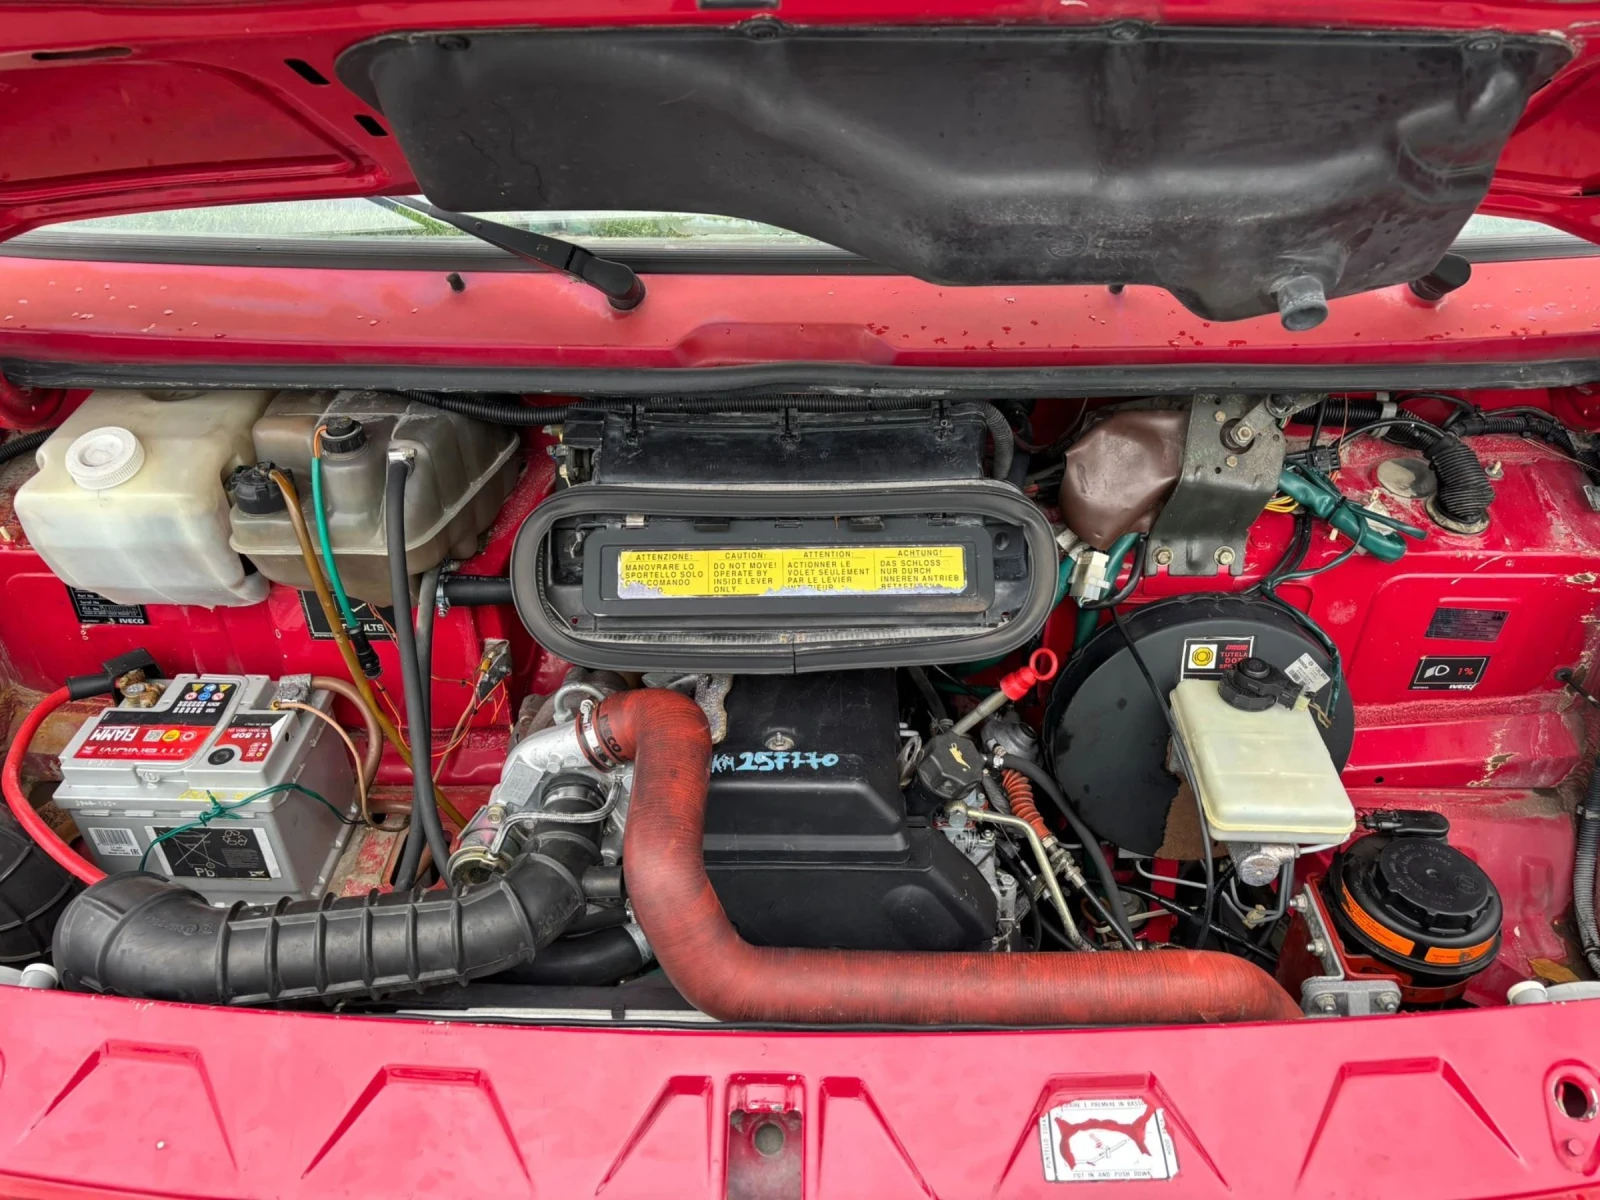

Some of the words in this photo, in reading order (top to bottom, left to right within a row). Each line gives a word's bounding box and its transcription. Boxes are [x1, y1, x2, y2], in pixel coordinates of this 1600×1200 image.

[636, 553, 693, 561] ATTENZIONE:
[725, 552, 767, 560] CAUTION:
[898, 549, 942, 557] ACHTUNG!
[625, 563, 680, 571] MANOVRARE
[713, 562, 725, 570] DO
[787, 561, 837, 569] ACTIONNER
[901, 559, 941, 567] SCHLOSS
[625, 571, 676, 579] SPORTELLO
[680, 570, 704, 578] SOLO
[787, 568, 815, 576] VOLET
[818, 568, 870, 576] SEULEMENT
[901, 567, 931, 575] DURCH
[745, 577, 773, 585] LEVER
[787, 576, 804, 584] PAR
[807, 576, 819, 584] LE
[821, 576, 853, 584] LEVIER
[880, 575, 919, 583] INNEREN
[713, 585, 740, 593] ONLY.
[89, 727, 140, 742] FIAMM
[600, 713, 623, 753] IVECO
[194, 867, 216, 877] Pb
